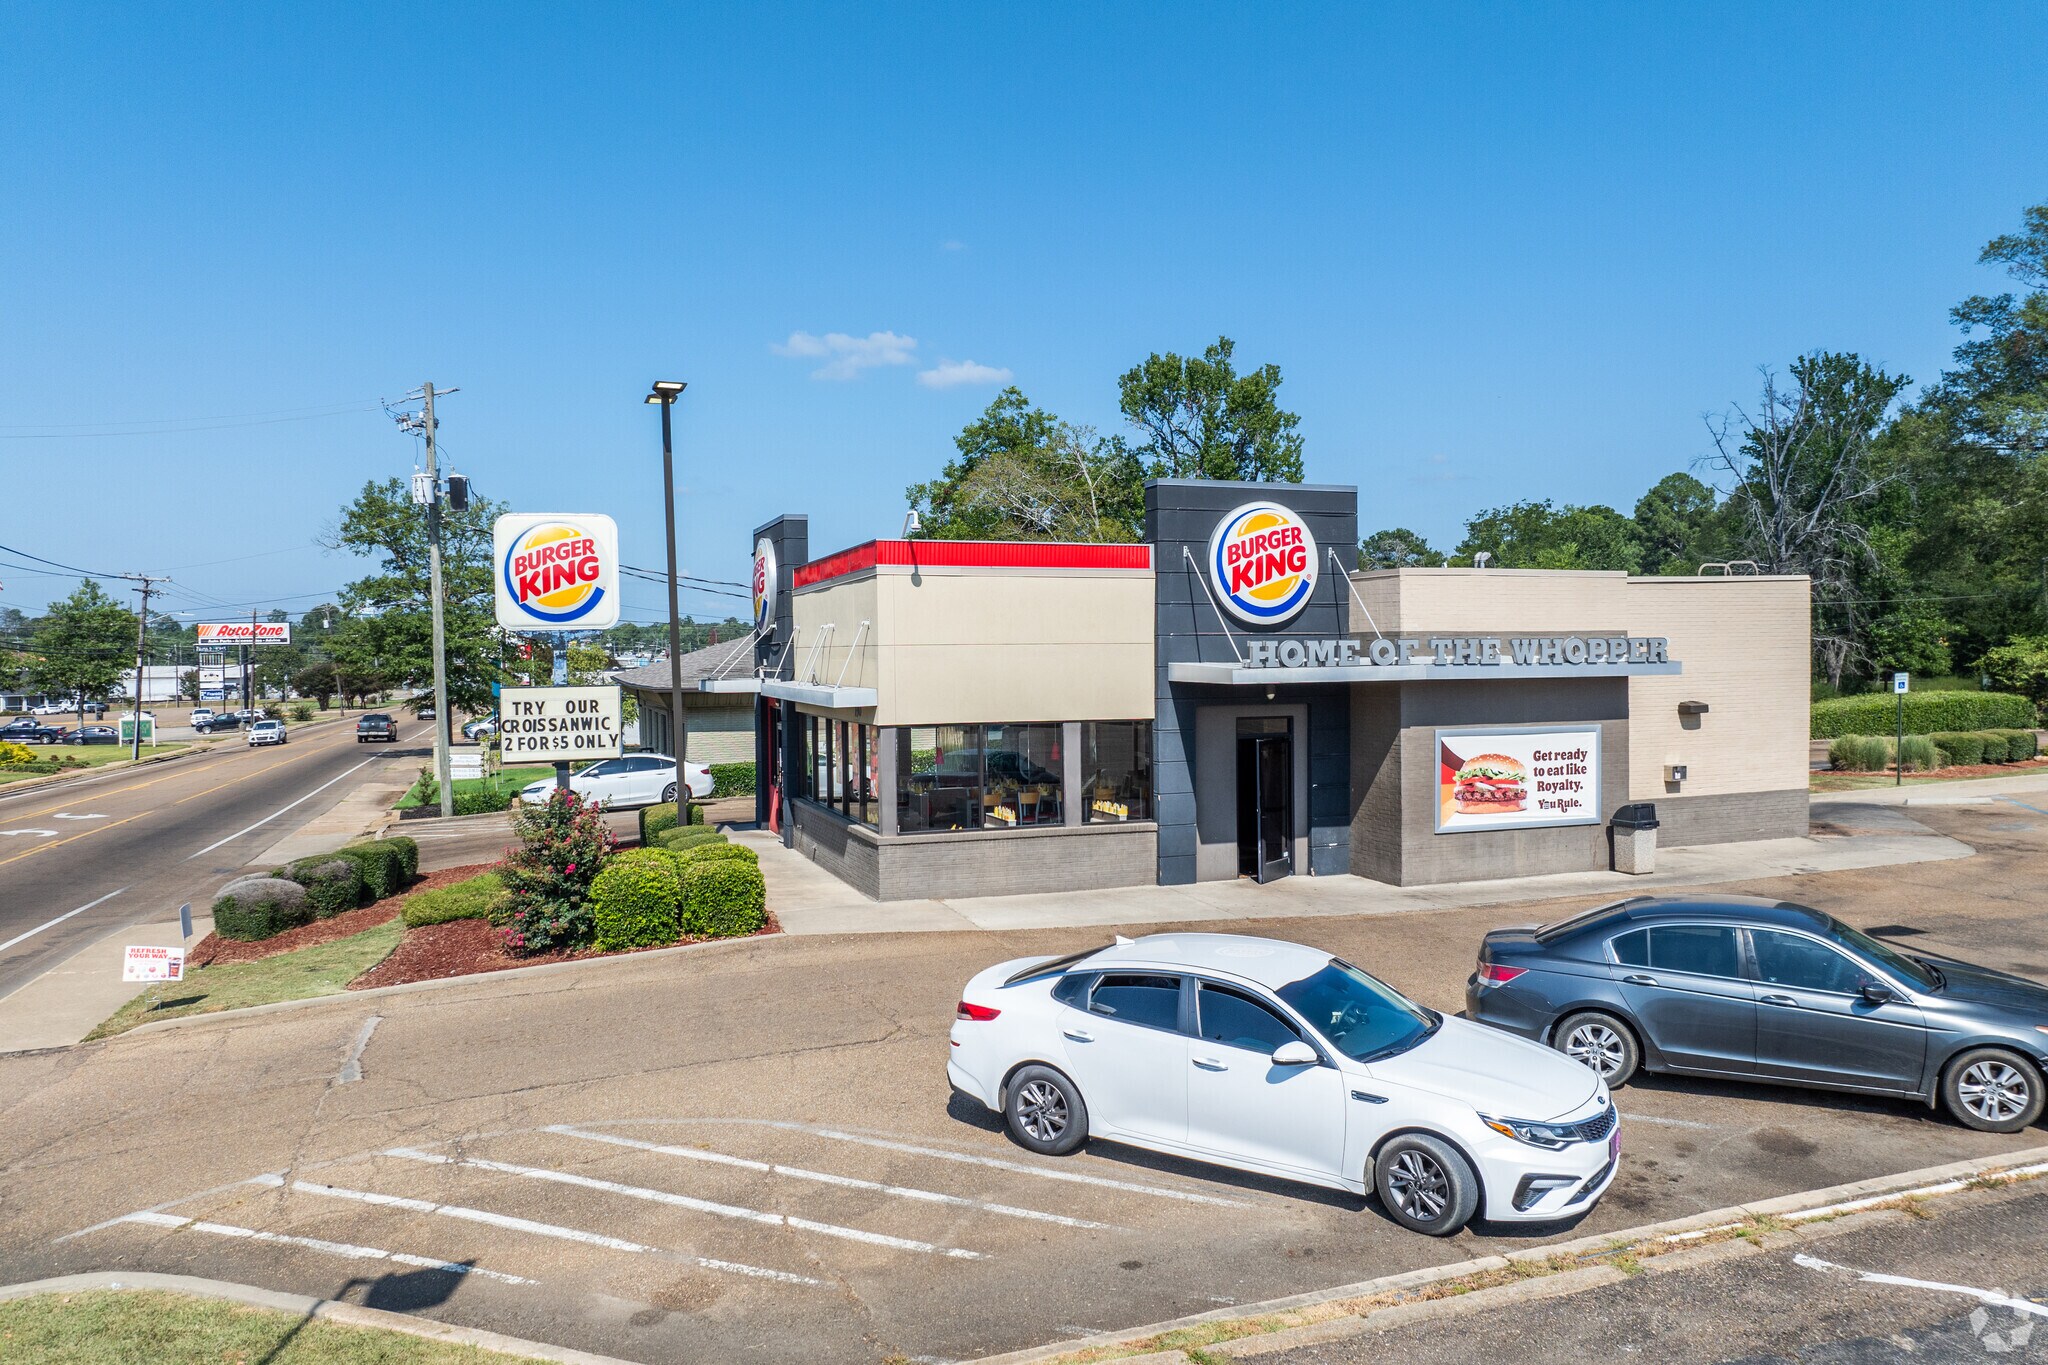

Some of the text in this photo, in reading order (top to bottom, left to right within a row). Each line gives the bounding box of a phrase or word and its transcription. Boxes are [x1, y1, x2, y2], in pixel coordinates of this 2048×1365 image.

[1227, 526, 1303, 566] BURGER
[514, 538, 596, 577] BURGER
[1231, 545, 1307, 594] KING
[518, 555, 600, 604] KING
[216, 624, 284, 637] AutoZone
[1245, 636, 1670, 668] HOME OF THE WHOPPER
[512, 700, 599, 716] TRY OUR
[501, 716, 611, 734] CROISSANWIC
[504, 737, 513, 751] 2
[576, 733, 619, 749] ONLY
[1533, 748, 1588, 763] Get ready
[1533, 763, 1587, 777] to eat like
[1537, 779, 1584, 794] Royalty.
[1557, 798, 1582, 813] Rule.
